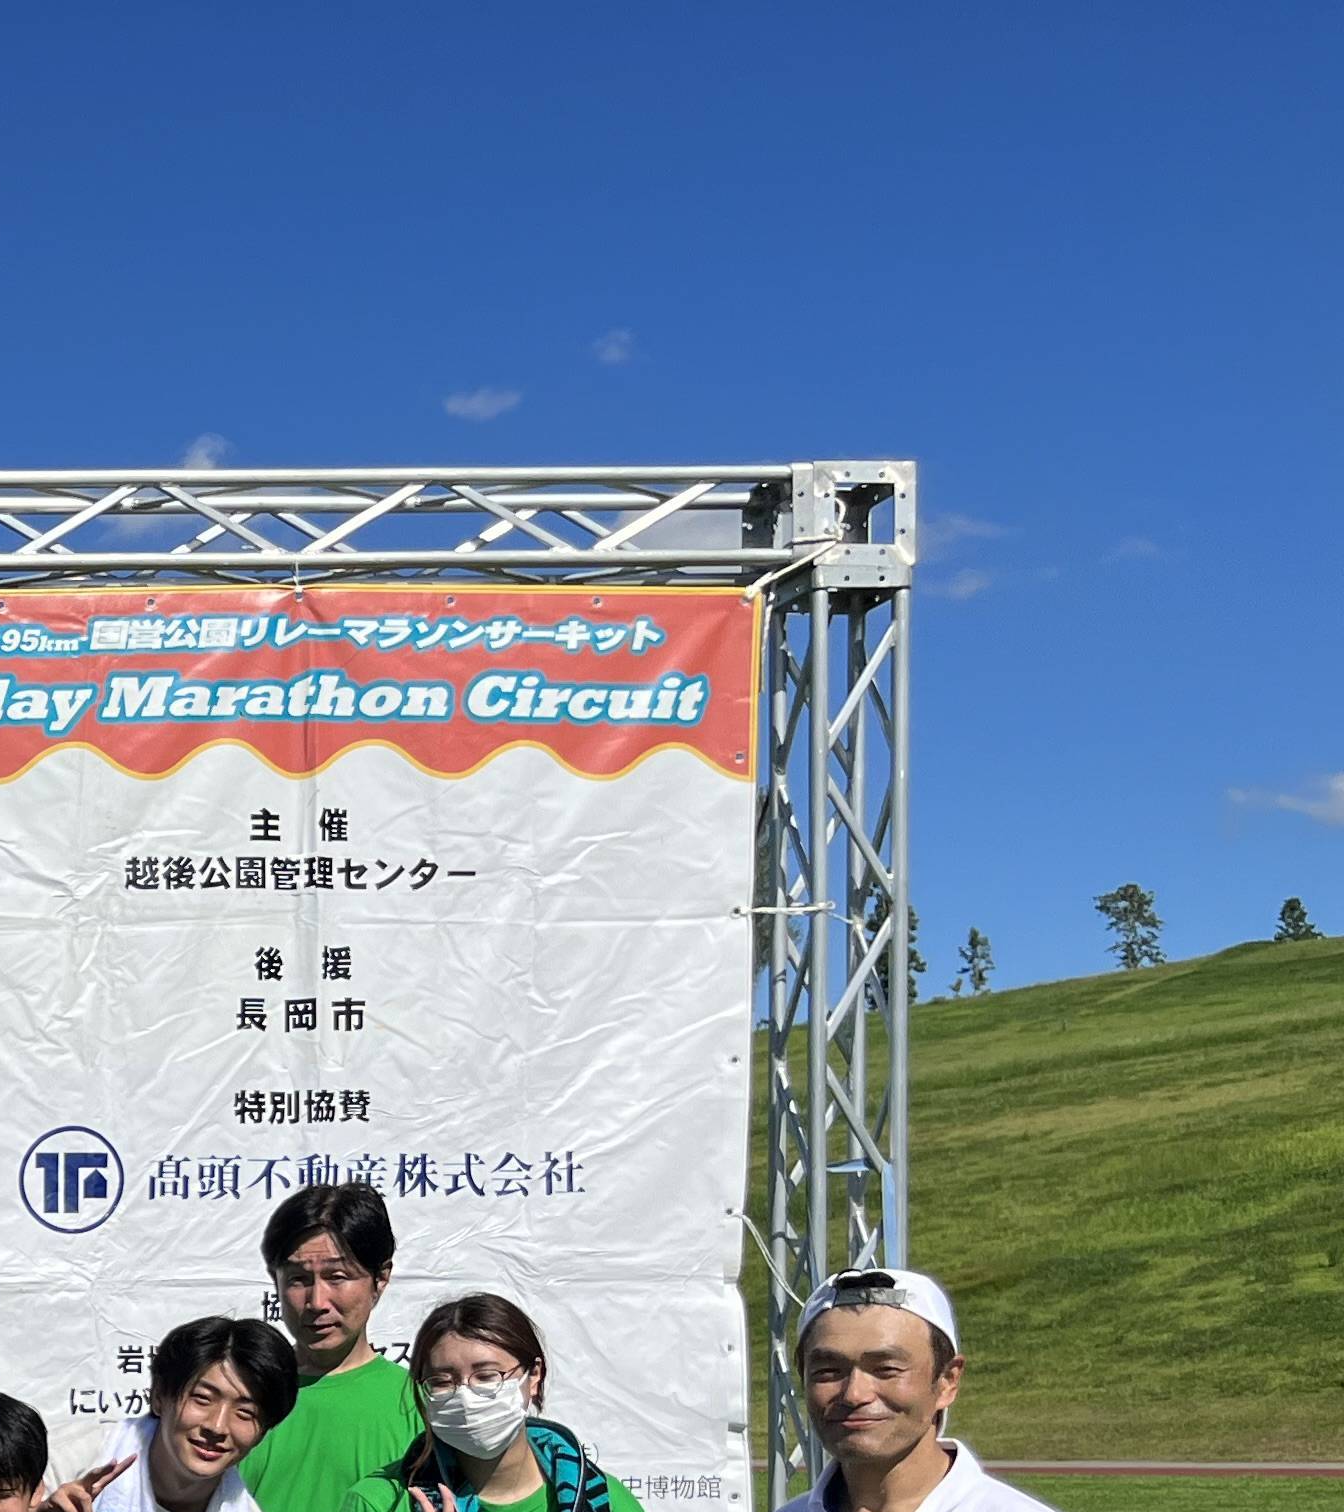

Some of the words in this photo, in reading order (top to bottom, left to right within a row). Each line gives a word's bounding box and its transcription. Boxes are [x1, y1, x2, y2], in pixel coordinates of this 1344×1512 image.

[90, 617, 662, 652] 国営公園リレーマラソンサーキット
[101, 674, 450, 720] Marathon
[467, 674, 705, 722] Circuit
[124, 856, 477, 891] 越後公園管理センター
[236, 997, 367, 1033] 長岡市
[234, 1089, 371, 1125] 特別協賛
